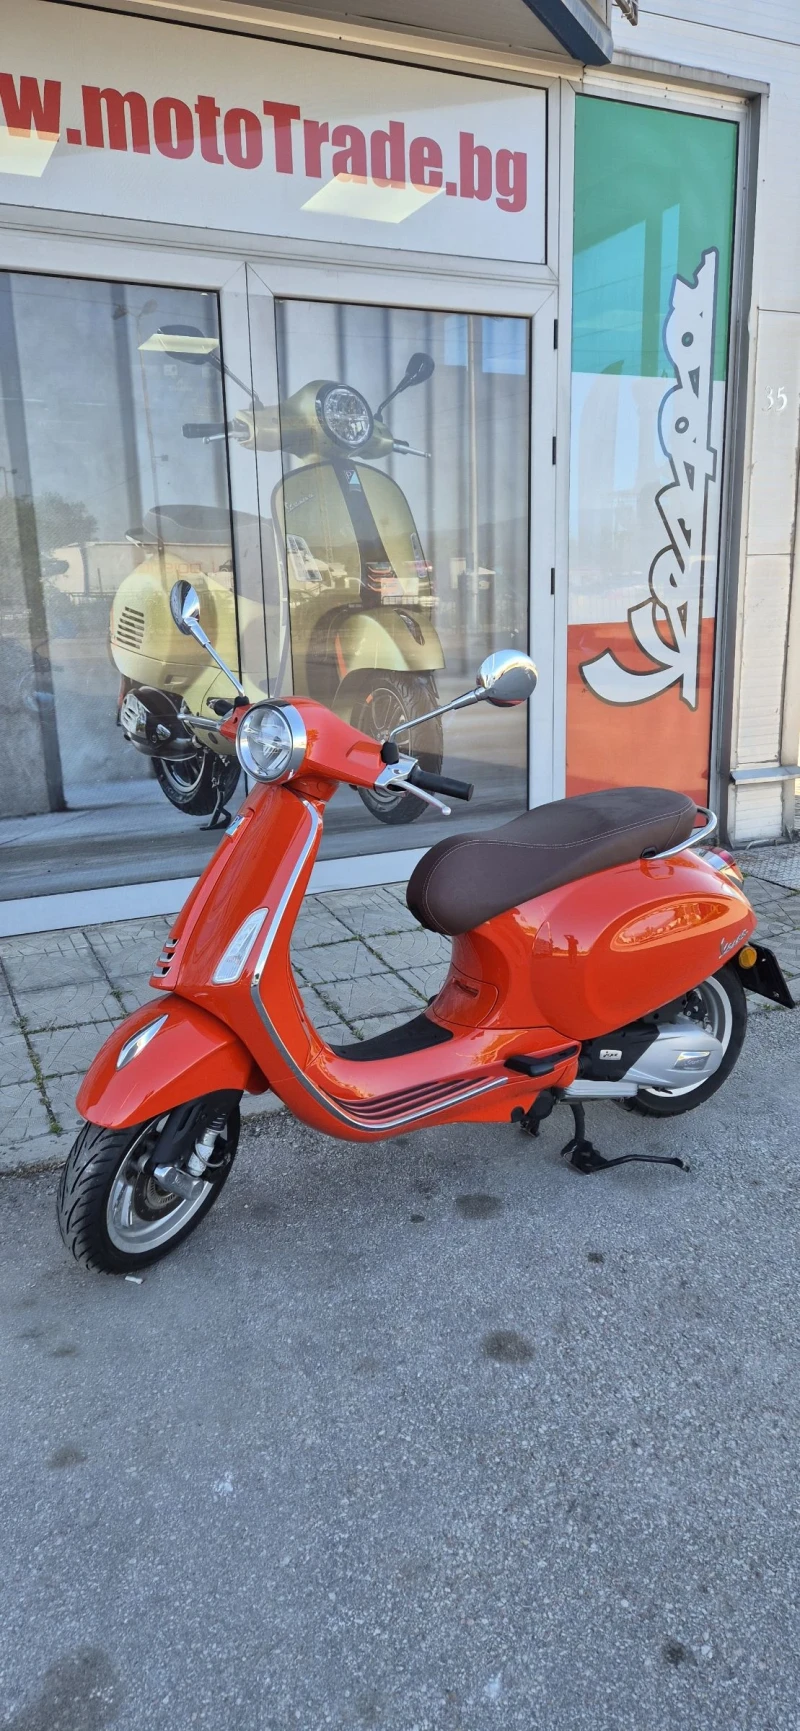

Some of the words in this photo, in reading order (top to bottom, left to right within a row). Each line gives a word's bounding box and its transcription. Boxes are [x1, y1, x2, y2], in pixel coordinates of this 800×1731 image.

[0, 72, 527, 213] w.motoTrade.bg
[762, 385, 788, 412] 35
[580, 246, 718, 711] Vespa
